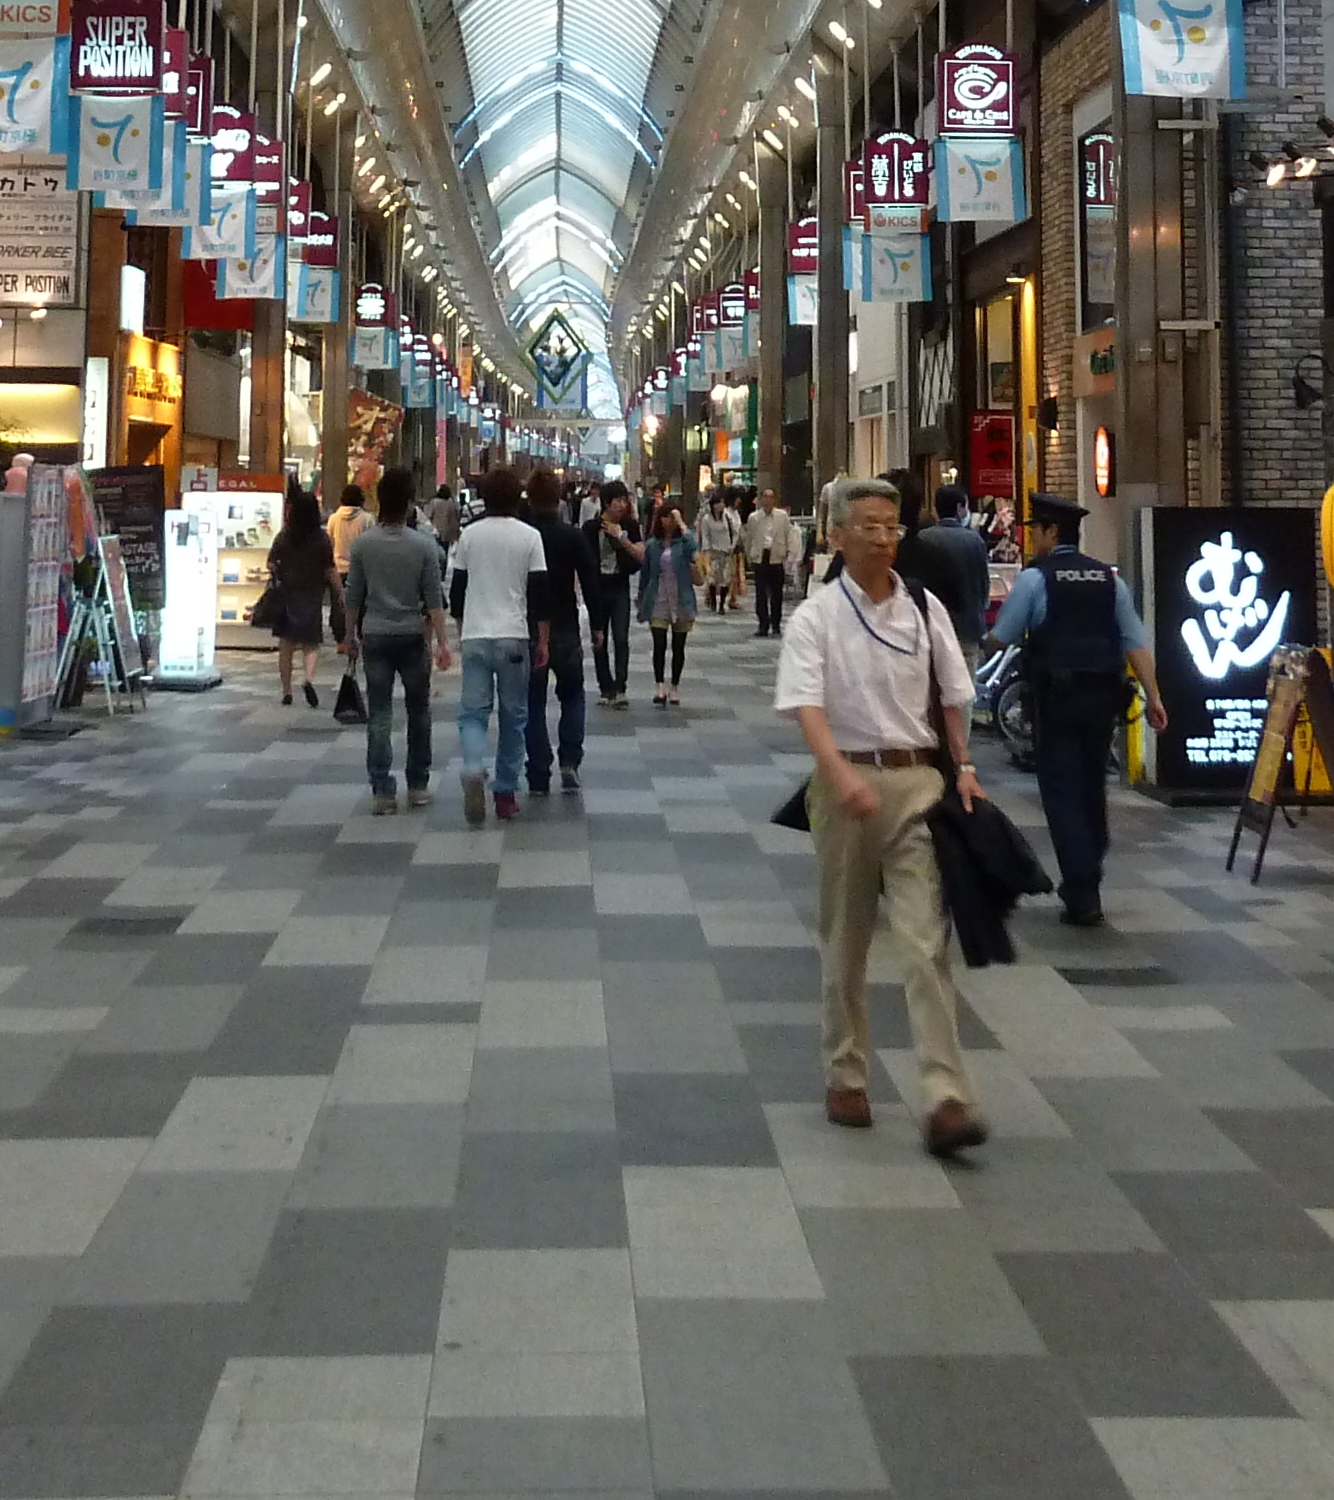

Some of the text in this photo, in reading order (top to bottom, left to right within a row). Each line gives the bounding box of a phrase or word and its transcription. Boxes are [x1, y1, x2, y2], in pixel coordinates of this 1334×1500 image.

[0, 4, 52, 23] KICS
[85, 15, 148, 47] SUPER
[78, 46, 154, 78] POSITION
[888, 216, 918, 228] KICS
[42, 246, 73, 259] BEE
[25, 274, 71, 295] POSITION
[1055, 569, 1107, 582] POLICE
[1185, 749, 1209, 762] TEL
